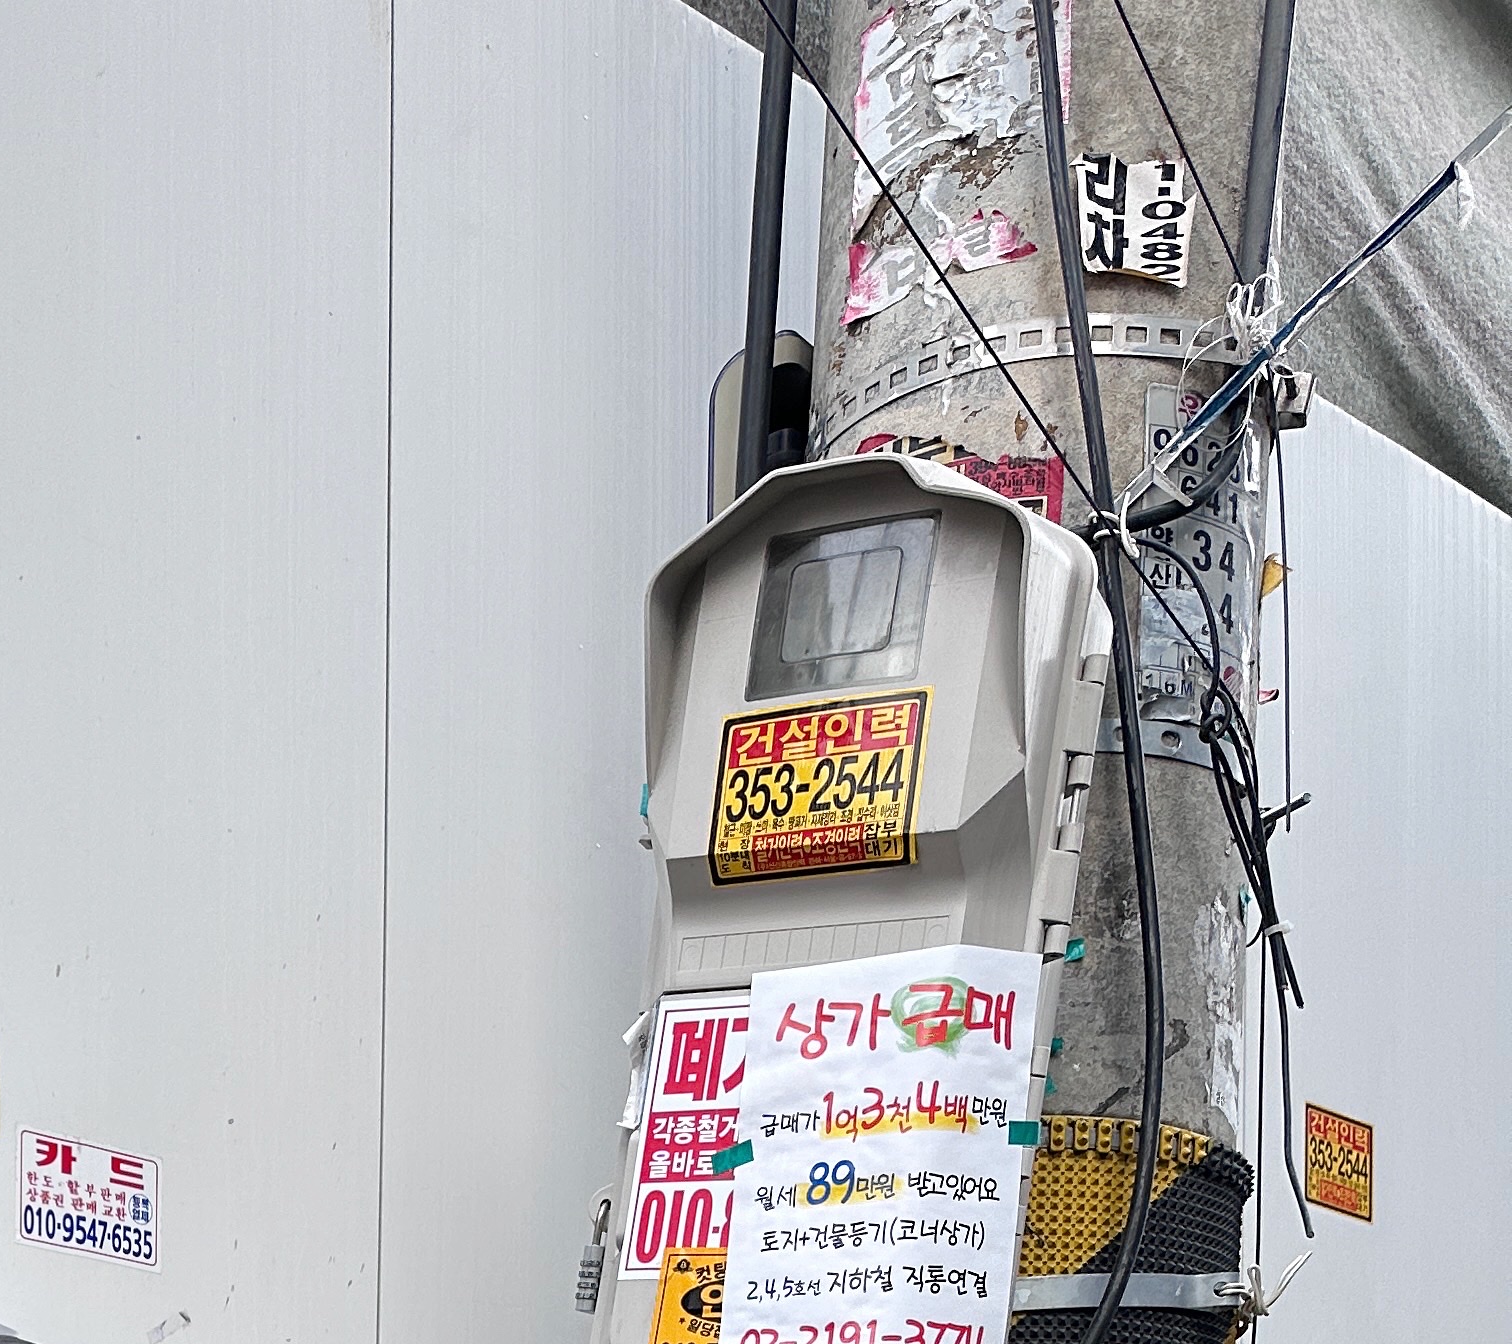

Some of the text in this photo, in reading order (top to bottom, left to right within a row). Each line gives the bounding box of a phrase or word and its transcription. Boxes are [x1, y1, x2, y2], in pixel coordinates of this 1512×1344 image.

[1192, 529, 1236, 582] 34
[737, 704, 911, 767] 건설인력
[725, 749, 905, 823] 353-2544
[864, 820, 898, 841] 잡부
[775, 981, 1017, 1061] 상가 급매
[1309, 1135, 1369, 1185] 353-2544
[755, 1185, 797, 1210] 월세
[906, 1171, 1001, 1204] 받고있어요
[827, 1265, 894, 1295] 지하철
[901, 1264, 989, 1299] 직통연결
